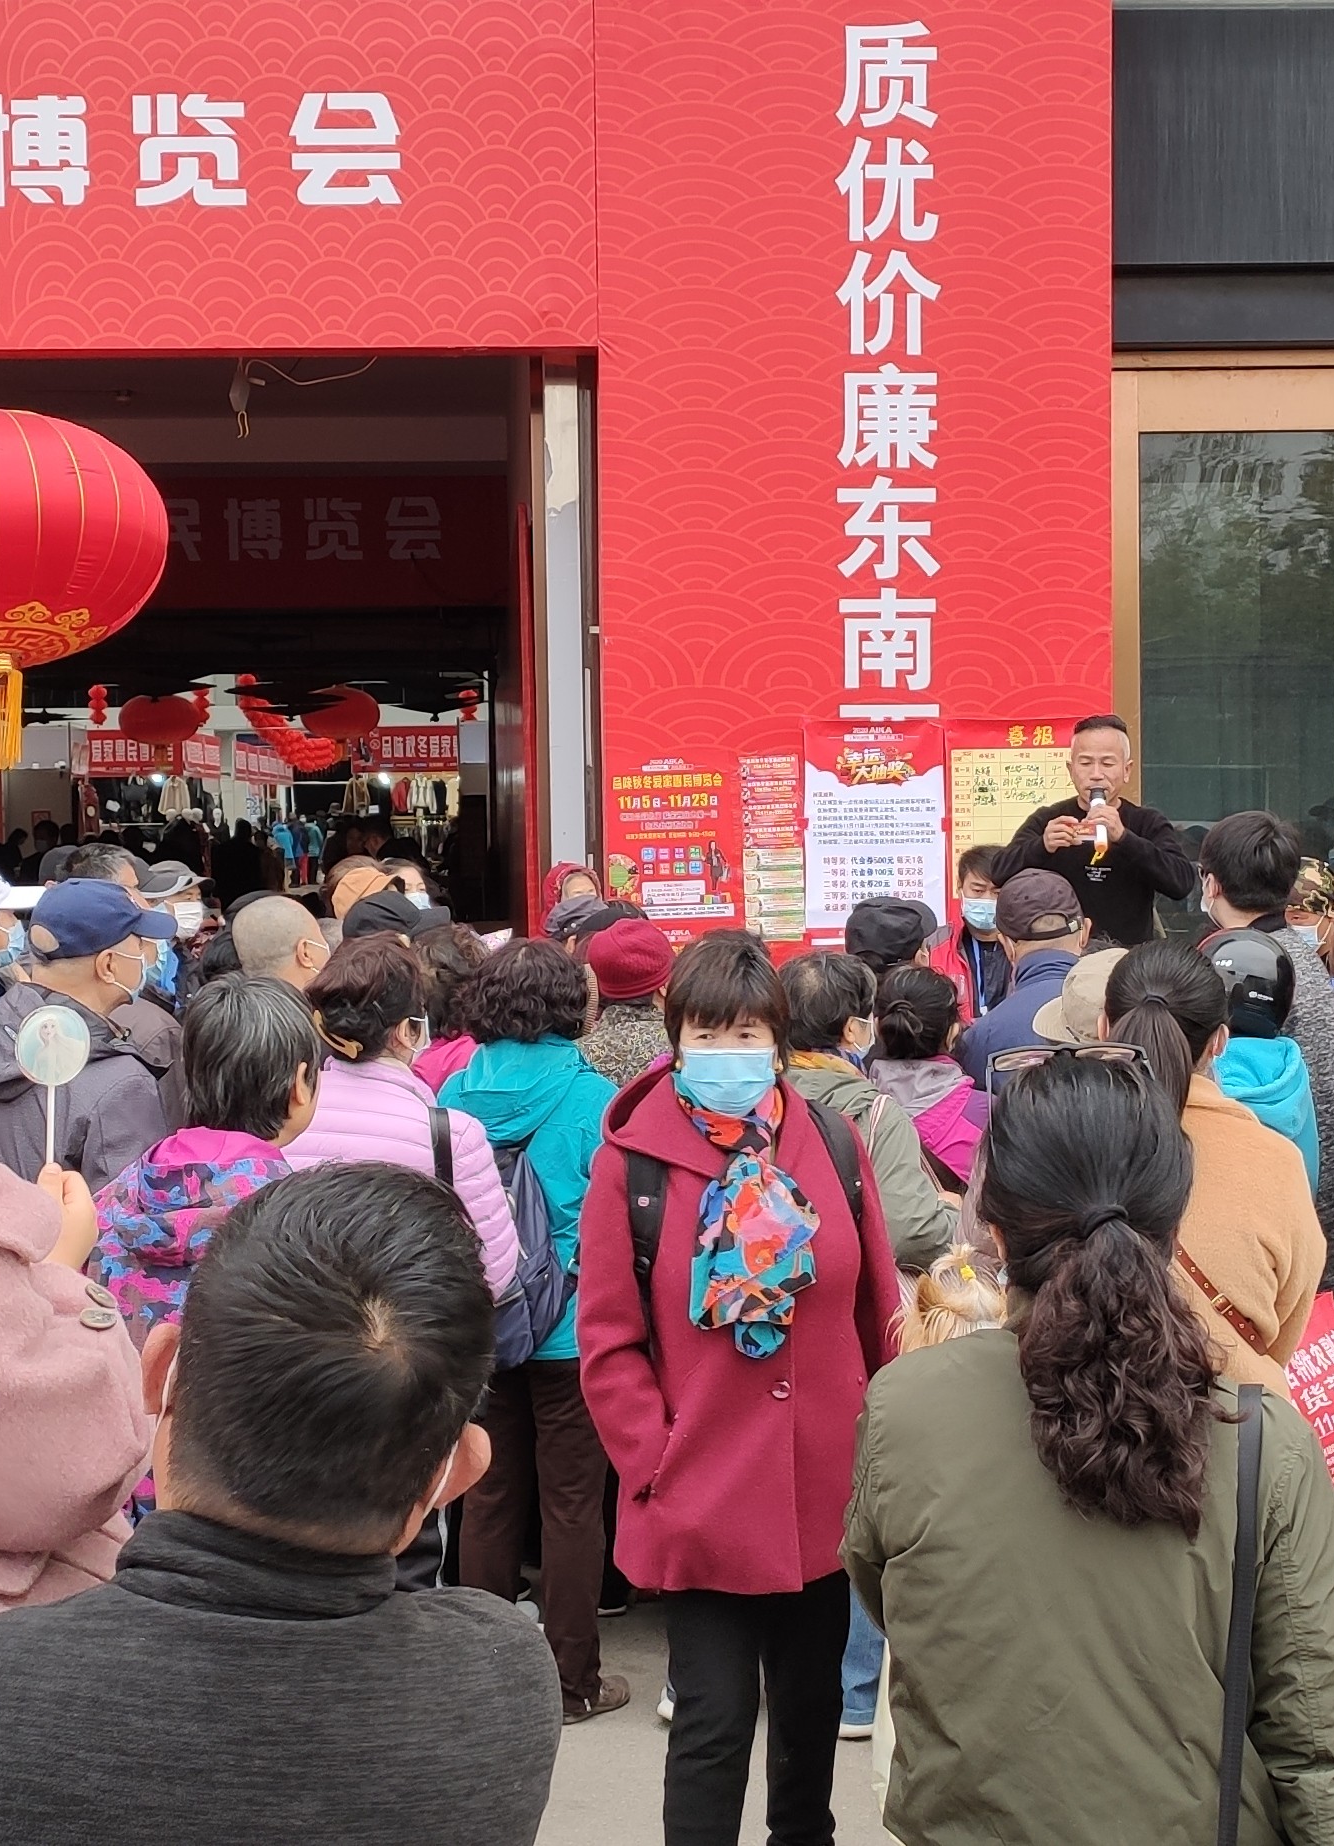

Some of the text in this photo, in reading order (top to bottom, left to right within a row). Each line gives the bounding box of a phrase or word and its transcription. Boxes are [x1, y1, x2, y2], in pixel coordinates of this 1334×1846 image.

[835, 21, 941, 721] 质优价廉东南
[1006, 725, 1054, 746] 喜报
[91, 739, 174, 762] 爱家惠民博
[851, 761, 909, 784] 大抽奖
[618, 793, 718, 810] 11月5日-11月23日
